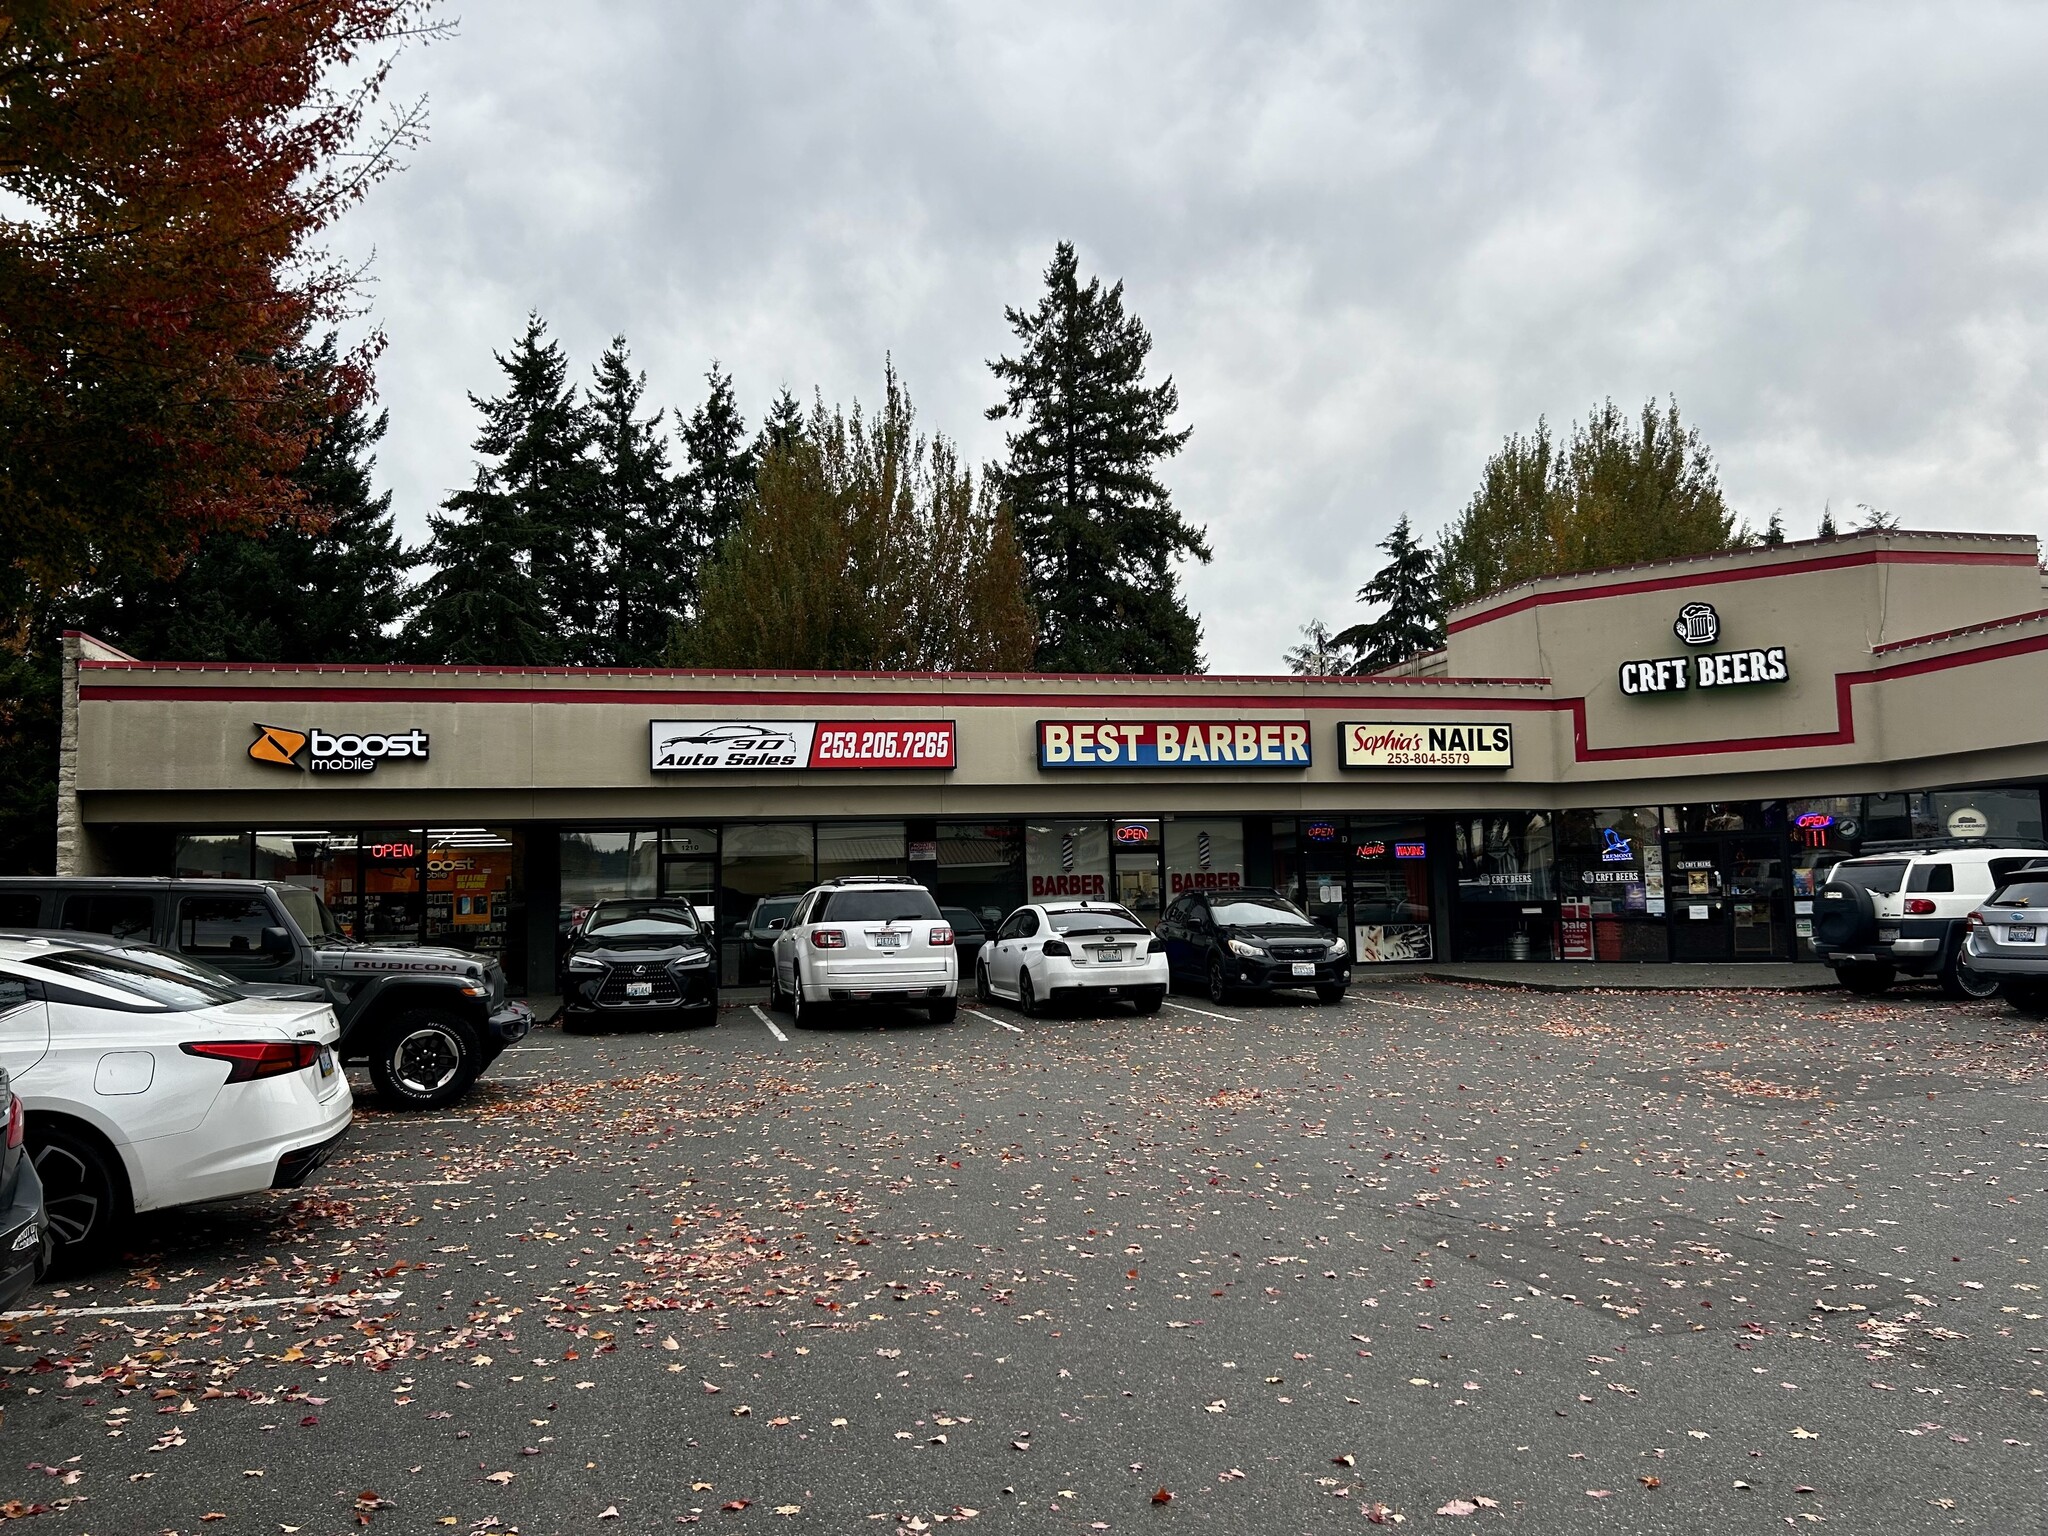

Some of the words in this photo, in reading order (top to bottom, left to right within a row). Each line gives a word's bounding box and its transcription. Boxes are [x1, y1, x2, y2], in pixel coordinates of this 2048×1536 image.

[1621, 659, 1687, 694] CRFT
[1697, 649, 1787, 687] BEERS
[311, 730, 427, 756] boost
[728, 740, 785, 750] 3D
[819, 731, 950, 759] 253.205.7265
[1045, 725, 1144, 762] BEST
[1156, 725, 1309, 762] BARBER
[1352, 726, 1423, 756] Sophia's
[1428, 727, 1509, 752] NAILS
[311, 757, 374, 770] mobile
[657, 753, 719, 766] Auto
[725, 752, 797, 766] Sales
[1387, 752, 1470, 764] 253-804-5579
[1798, 815, 1830, 827] OPEN
[1116, 828, 1148, 840] OPEN
[1308, 827, 1335, 837] OPEN
[372, 843, 414, 858] OPEN
[681, 844, 700, 852] 1210
[1356, 844, 1386, 856] Nails
[1395, 845, 1425, 856] WAXING
[427, 857, 475, 872] oost
[1171, 872, 1241, 893] BARBER
[1491, 874, 1509, 884] CRFT
[1510, 874, 1532, 883] BEERS
[1595, 872, 1614, 882] CRFT
[1615, 872, 1639, 882] BEERS
[1032, 874, 1105, 896] BARBER
[574, 910, 590, 919] FO
[353, 961, 457, 972] RUBICON
